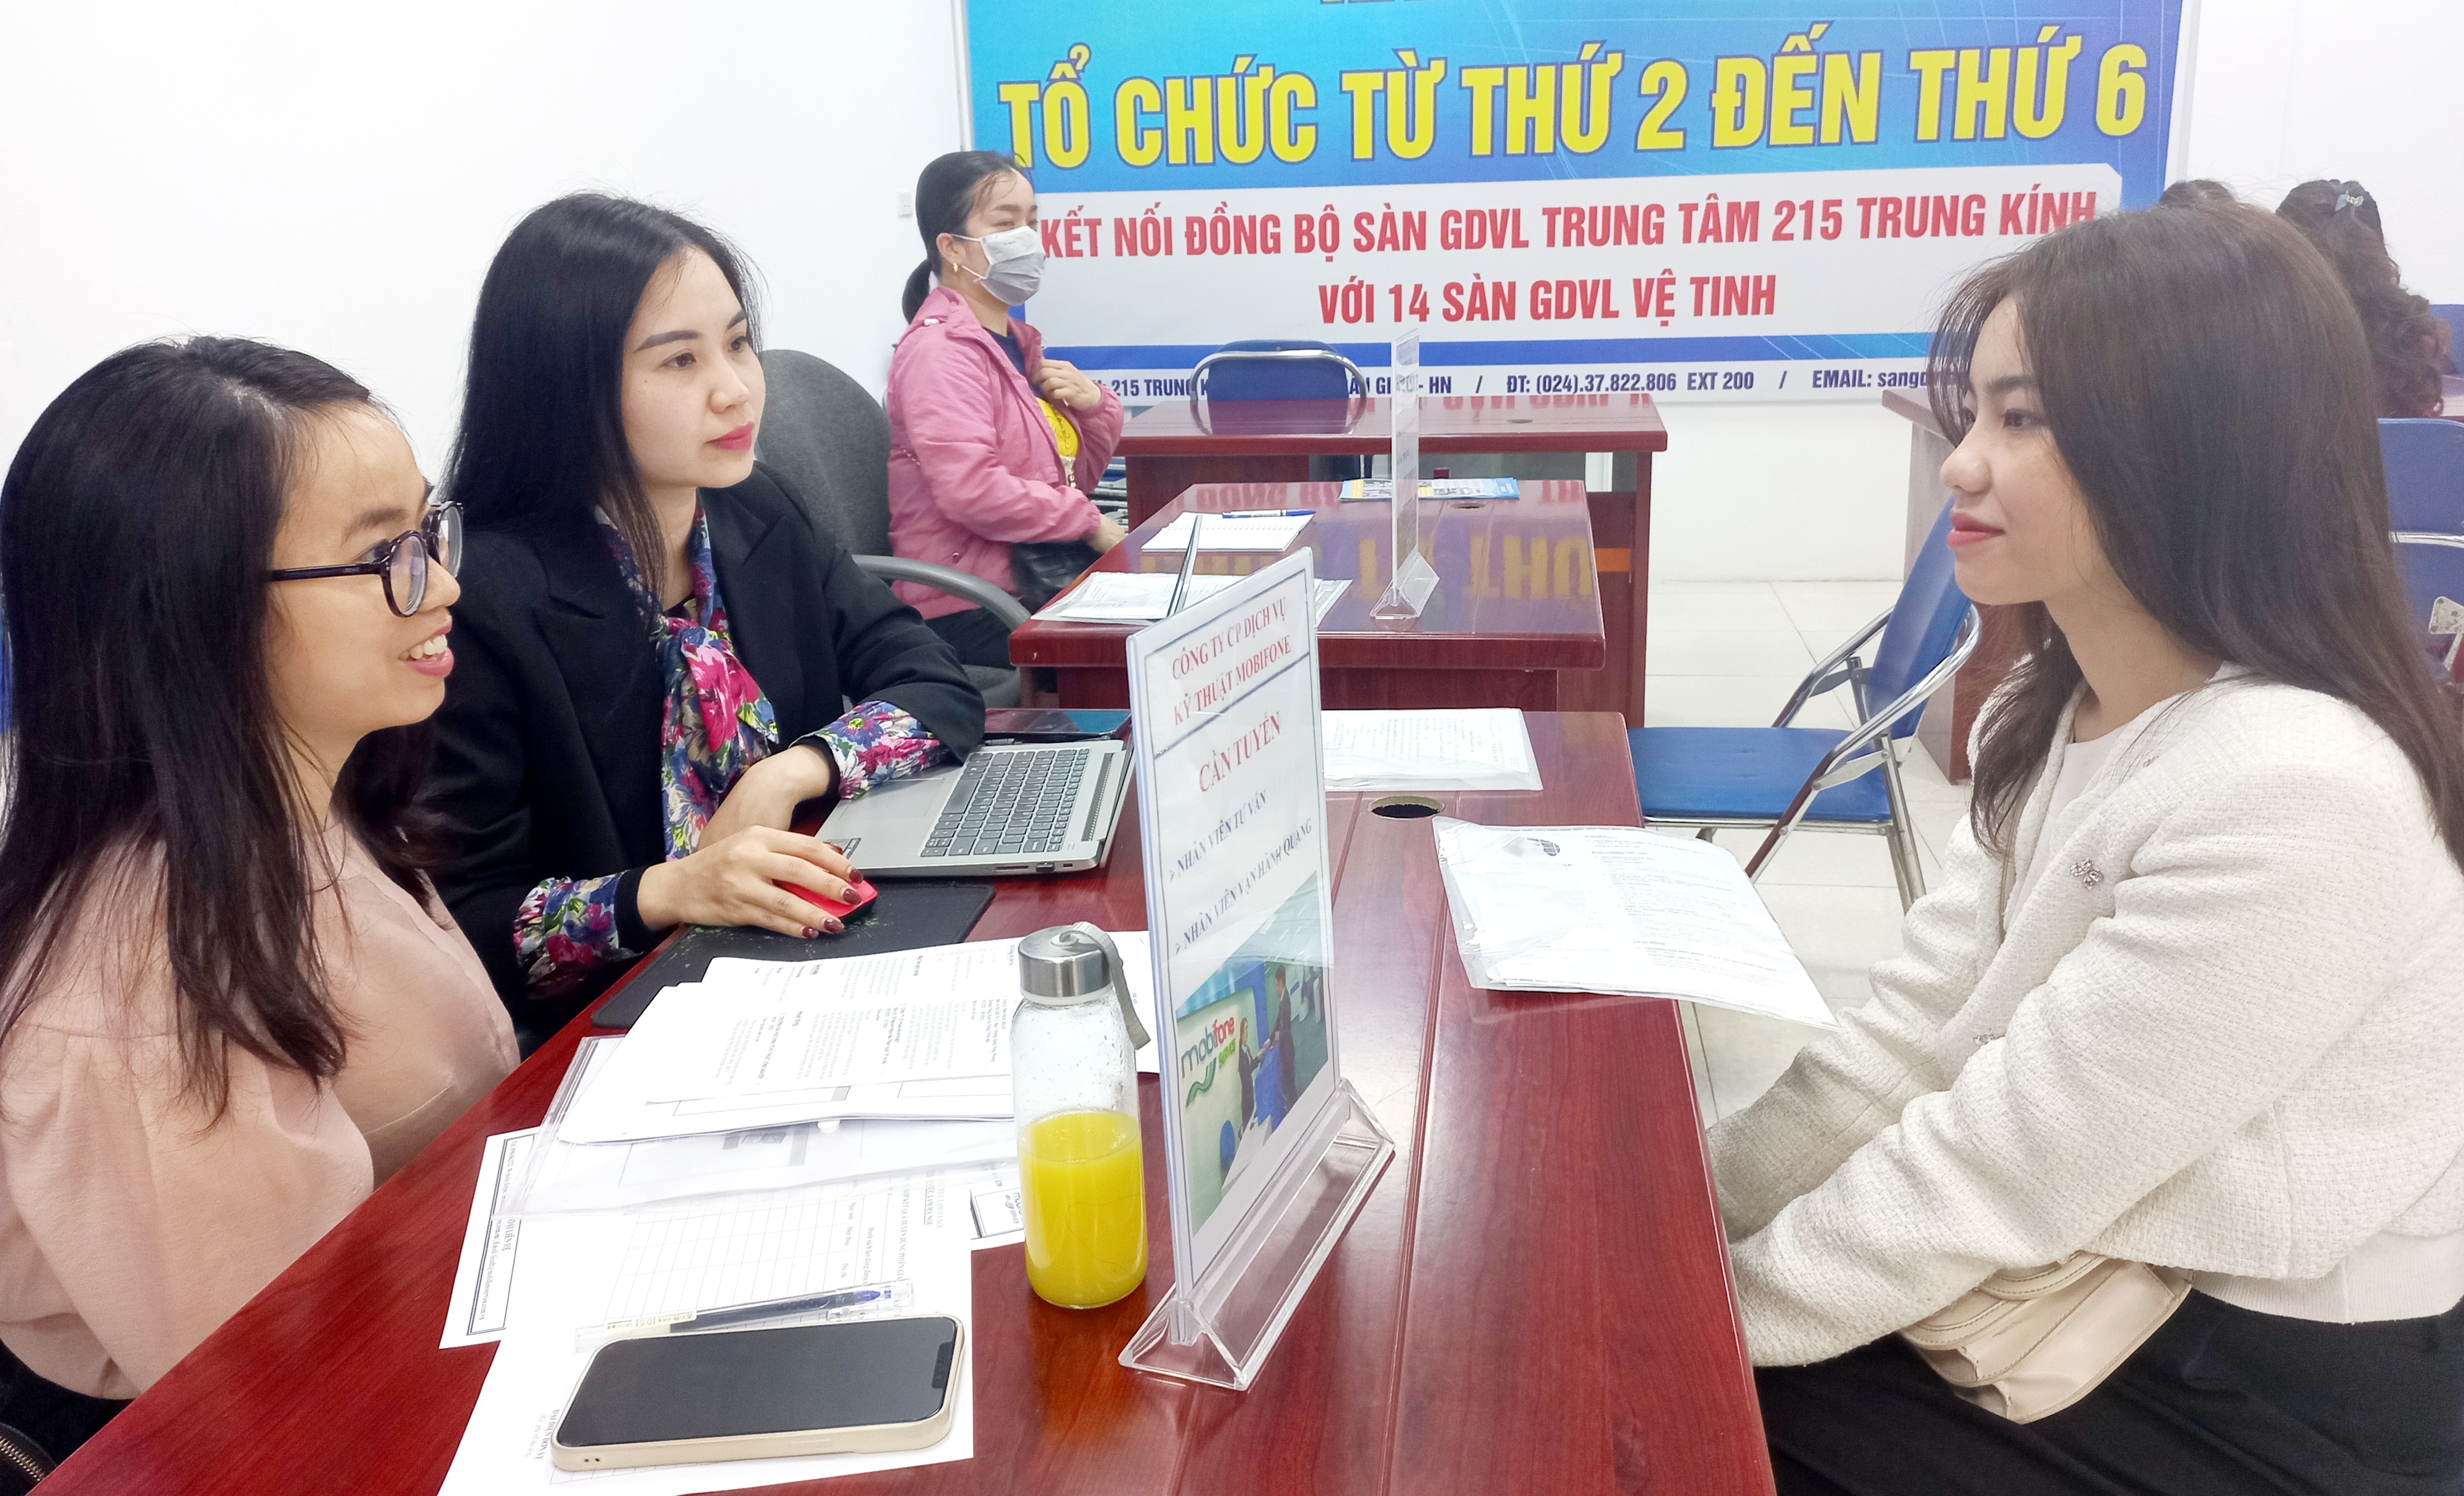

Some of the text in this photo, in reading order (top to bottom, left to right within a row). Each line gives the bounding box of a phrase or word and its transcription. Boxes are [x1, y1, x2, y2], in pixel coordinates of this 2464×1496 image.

[998, 22, 2147, 167] TỔ CHỨC TỪ THỨ 2 ĐẾN THỨ 6
[1040, 184, 2096, 262] KẾT NỐI ĐỒNG BỘ SÀN GDVL TRUNG TÂM 215 TRUNG KÍNH
[1318, 268, 1776, 327] VỚI 14 SÀN GDVL VỆ TINH
[1111, 379, 1139, 397] 215
[1429, 376, 1452, 394] HN
[1506, 375, 1531, 393] ĐT:
[1536, 373, 1677, 394] (024).37.822.806
[1688, 372, 1717, 390] EXT
[1723, 372, 1754, 390] 200
[1812, 369, 1871, 388] EMAIL:
[1172, 597, 1287, 681] CÔNG TY CP DỊCH VỤ
[1194, 669, 1233, 712] THUẬT
[1235, 634, 1292, 686] MOBIFONE
[1198, 747, 1231, 792] CẦN
[1233, 710, 1281, 767] TUYỂN
[1177, 840, 1207, 878] NHÂN
[1208, 819, 1233, 849] VIÊN
[1184, 911, 1213, 950] NHÂN
[1213, 888, 1237, 918] VIÊN
[1257, 845, 1282, 879] HÀNH
[1283, 818, 1312, 856] QUANG
[1181, 1016, 1235, 1079] mobifone
